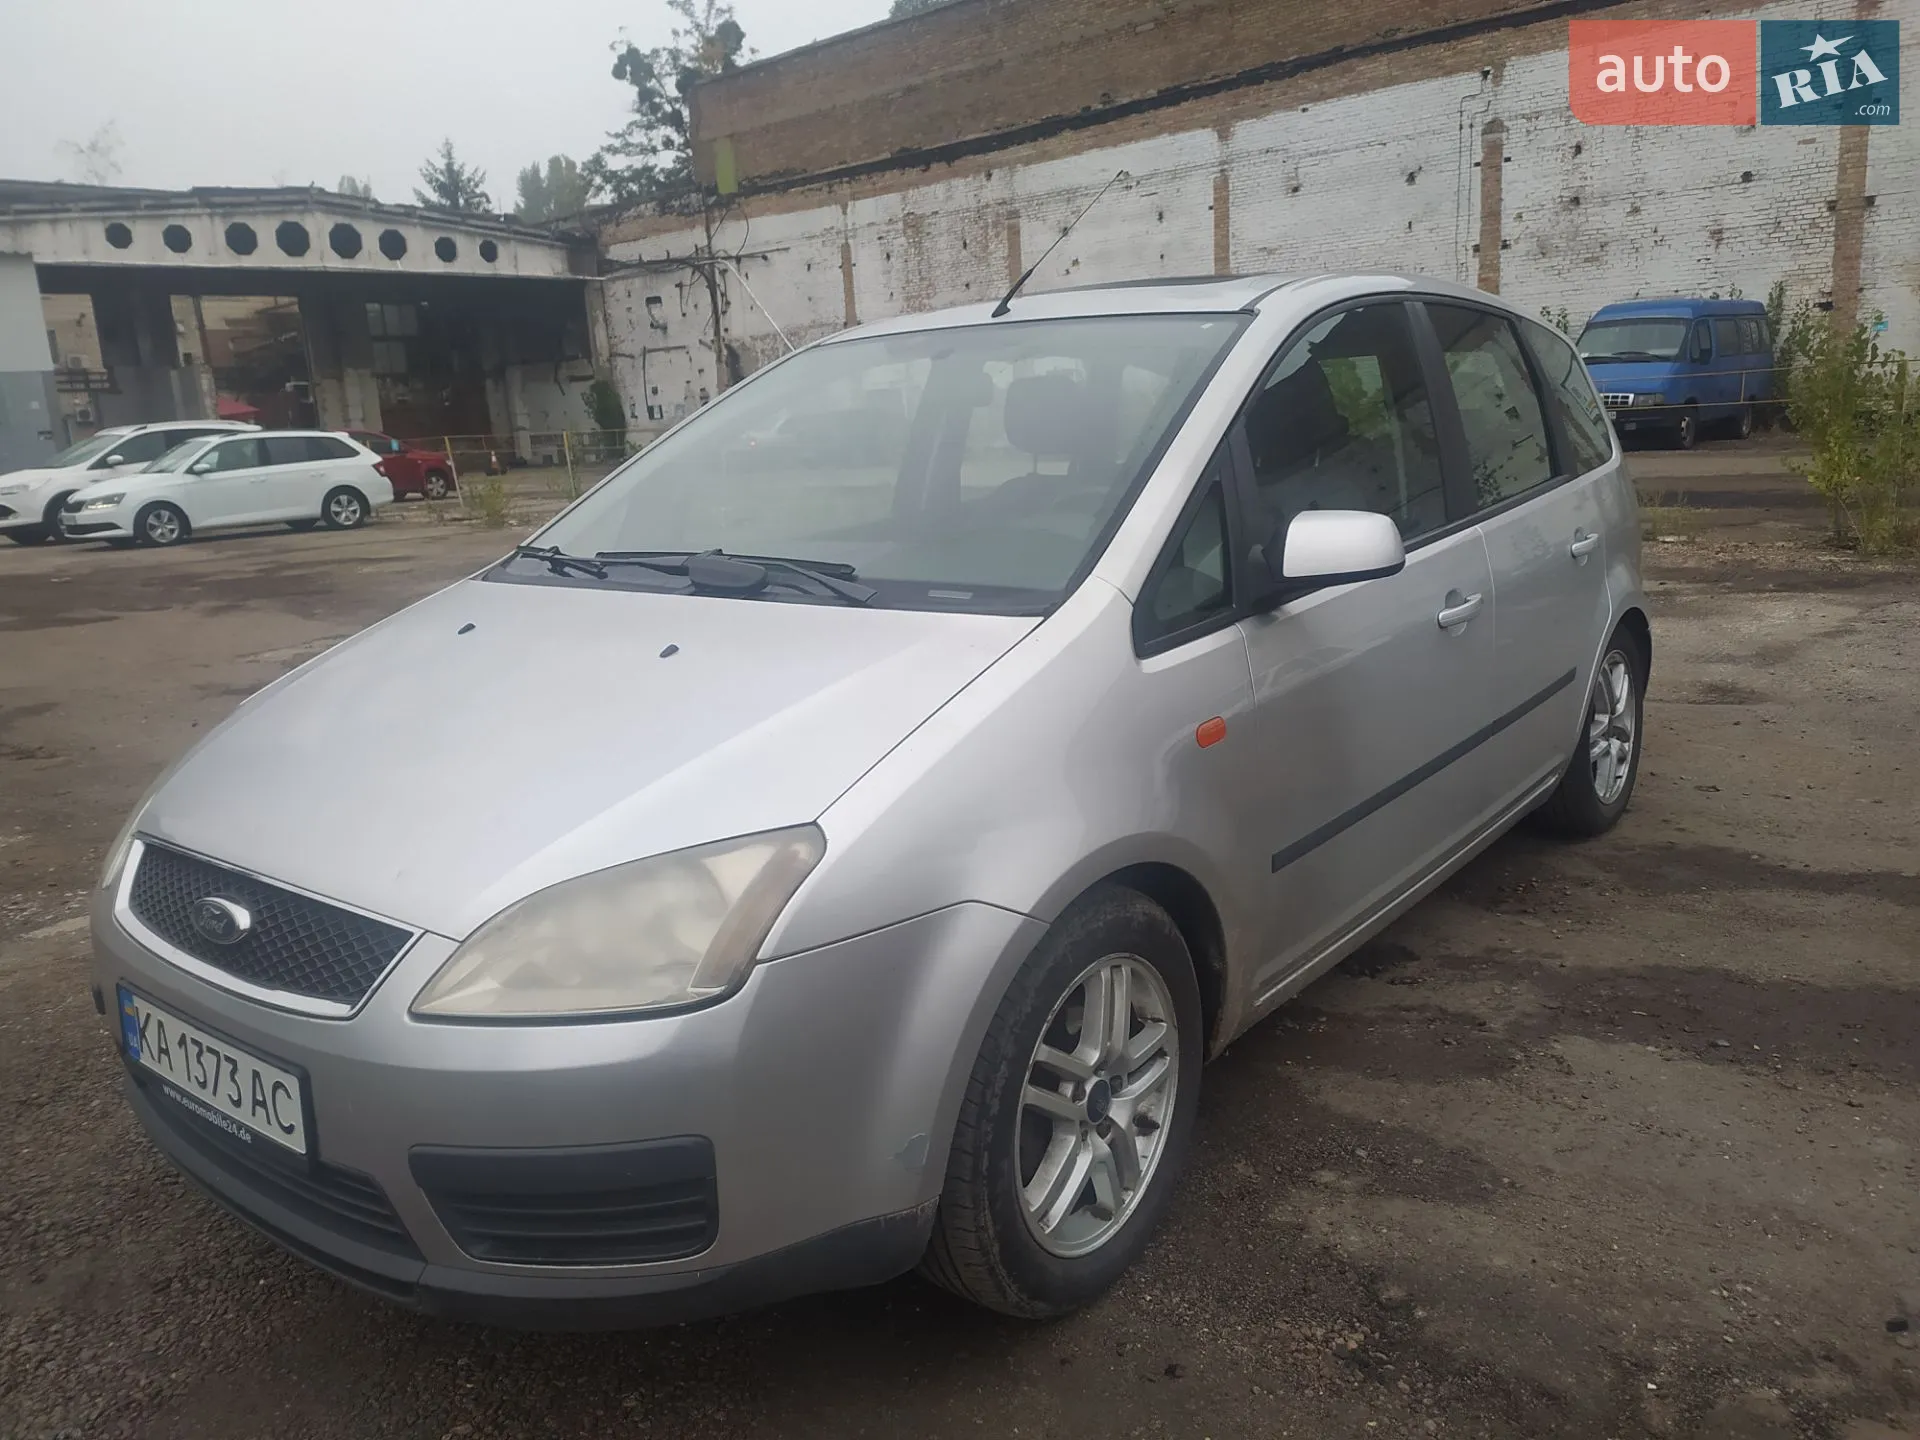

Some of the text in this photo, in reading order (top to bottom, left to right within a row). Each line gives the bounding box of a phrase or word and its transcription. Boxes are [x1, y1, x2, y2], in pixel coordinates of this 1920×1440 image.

[135, 1005, 295, 1135] KA 1373 AC
[162, 1083, 252, 1144] www.euromobile24.de
